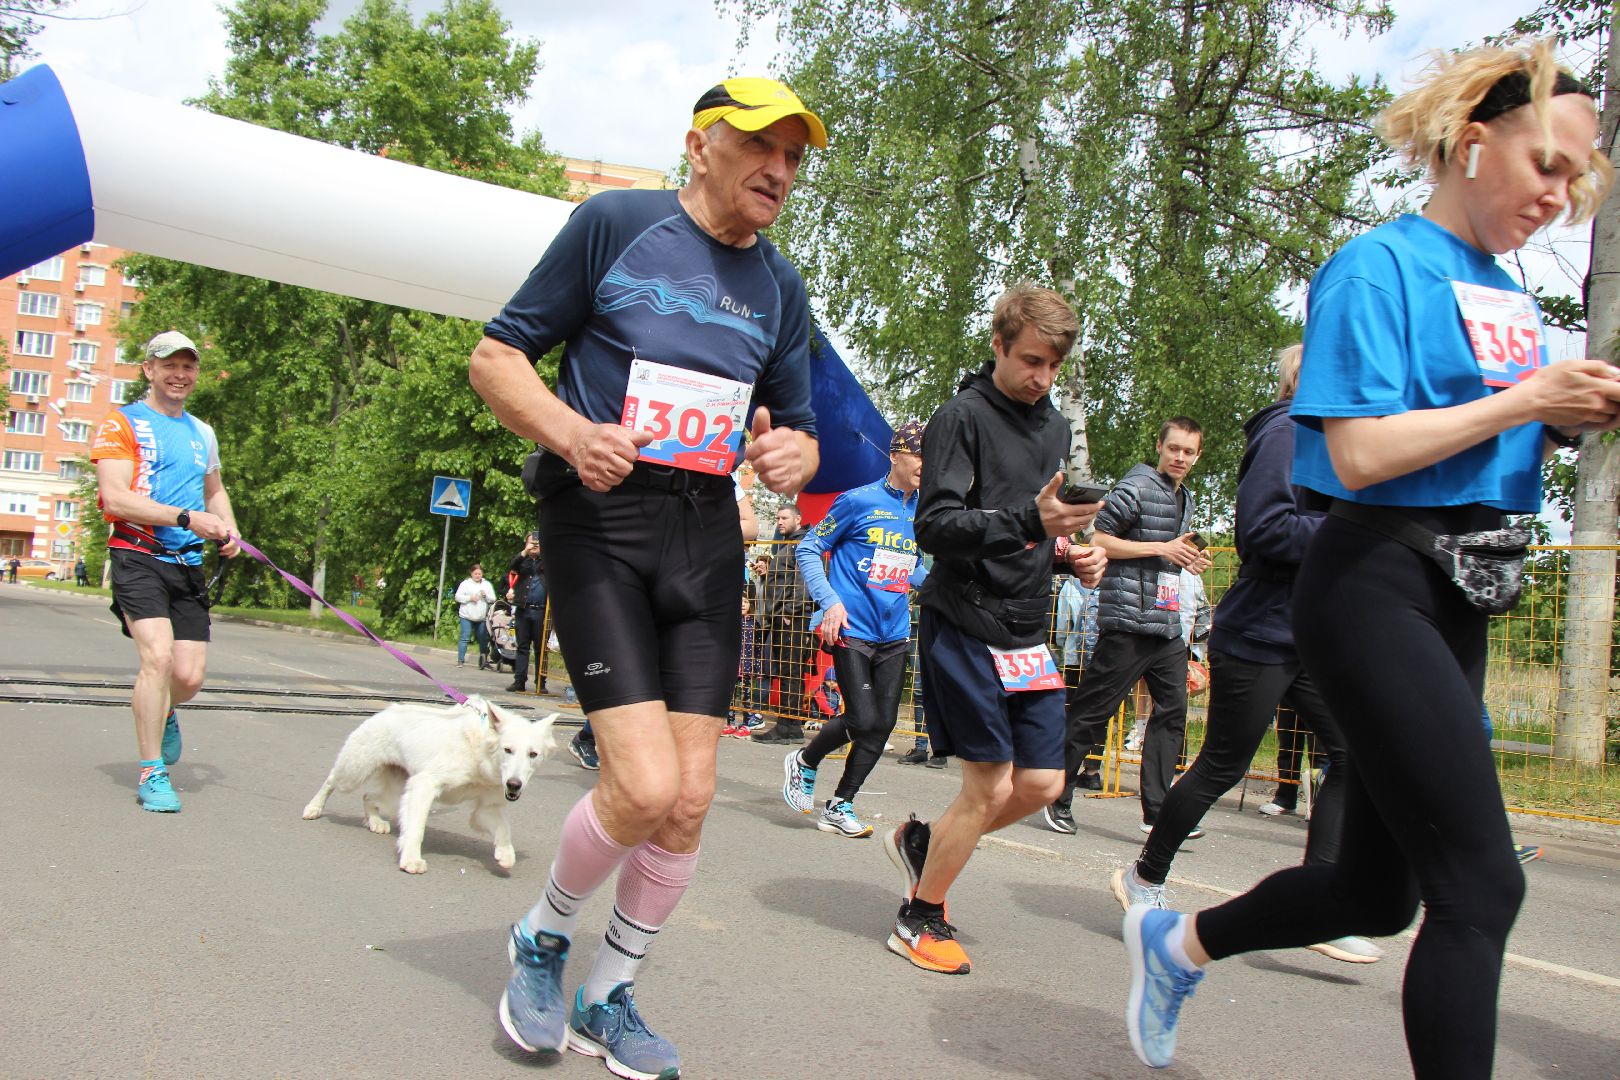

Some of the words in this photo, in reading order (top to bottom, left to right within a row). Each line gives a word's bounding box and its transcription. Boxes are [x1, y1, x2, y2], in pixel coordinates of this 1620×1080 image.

[720, 295, 751, 318] RUN
[1480, 321, 1537, 368] 367
[643, 399, 733, 454] 302
[877, 564, 910, 584] 340
[1160, 585, 1177, 601] 310
[1002, 652, 1046, 678] 337
